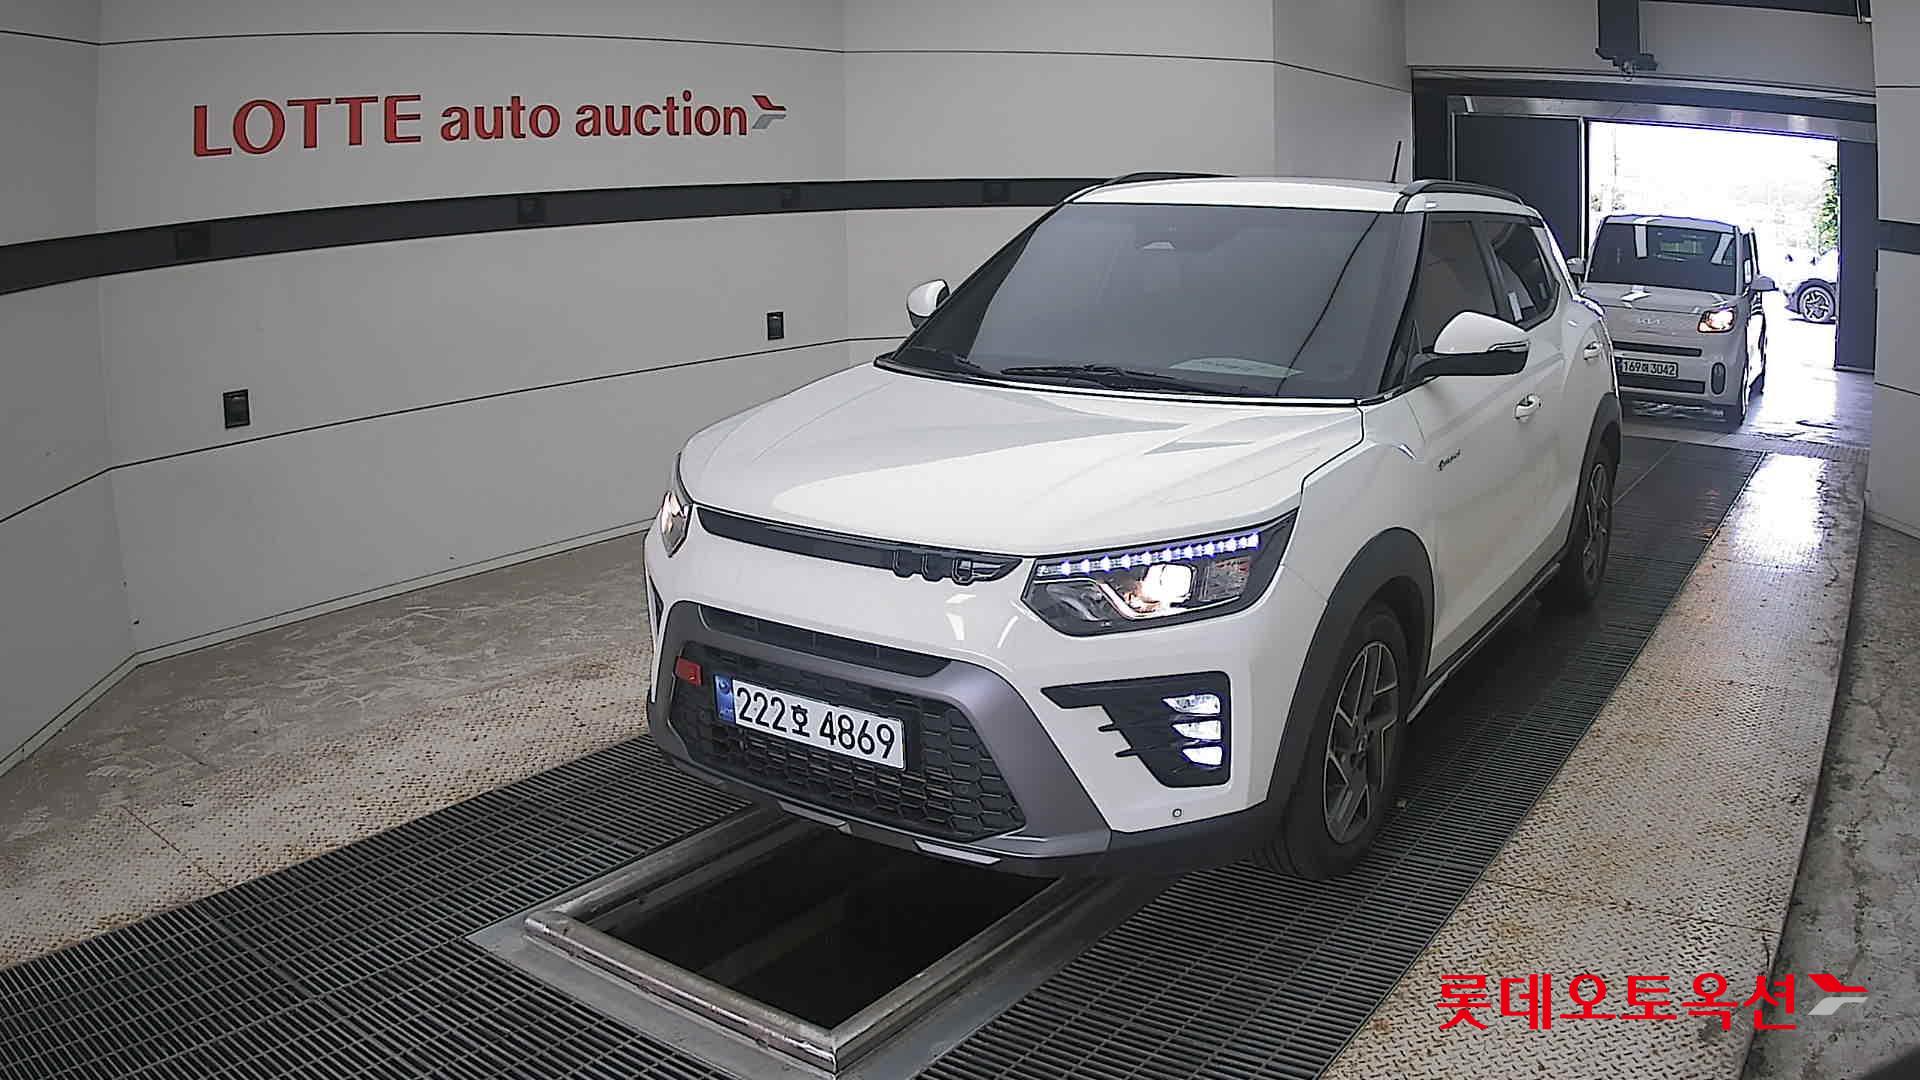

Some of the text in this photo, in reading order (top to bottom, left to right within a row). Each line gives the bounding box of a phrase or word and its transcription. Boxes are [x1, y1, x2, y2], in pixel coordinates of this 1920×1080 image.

[193, 90, 748, 157] LOTTE auto auction
[1650, 363, 1676, 376] 3042
[736, 687, 896, 759] 222호 4869
